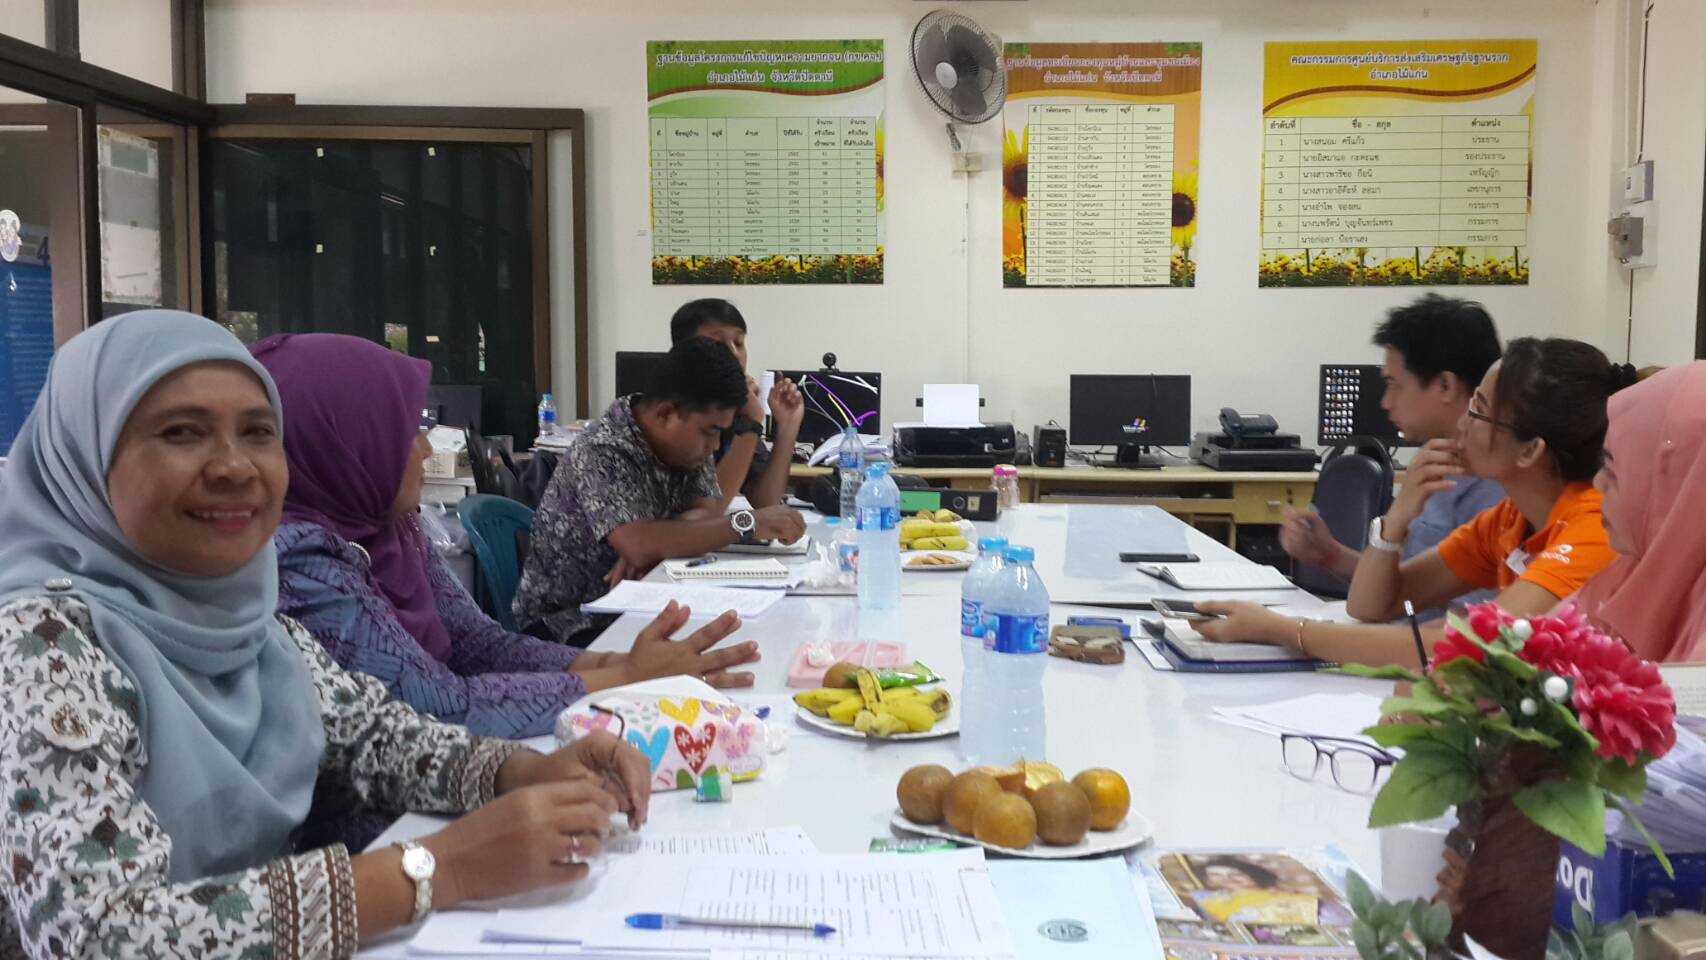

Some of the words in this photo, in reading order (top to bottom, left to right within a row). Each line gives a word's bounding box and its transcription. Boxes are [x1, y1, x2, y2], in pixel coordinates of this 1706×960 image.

[1370, 66, 1429, 80] อำเภอไม้แก่น
